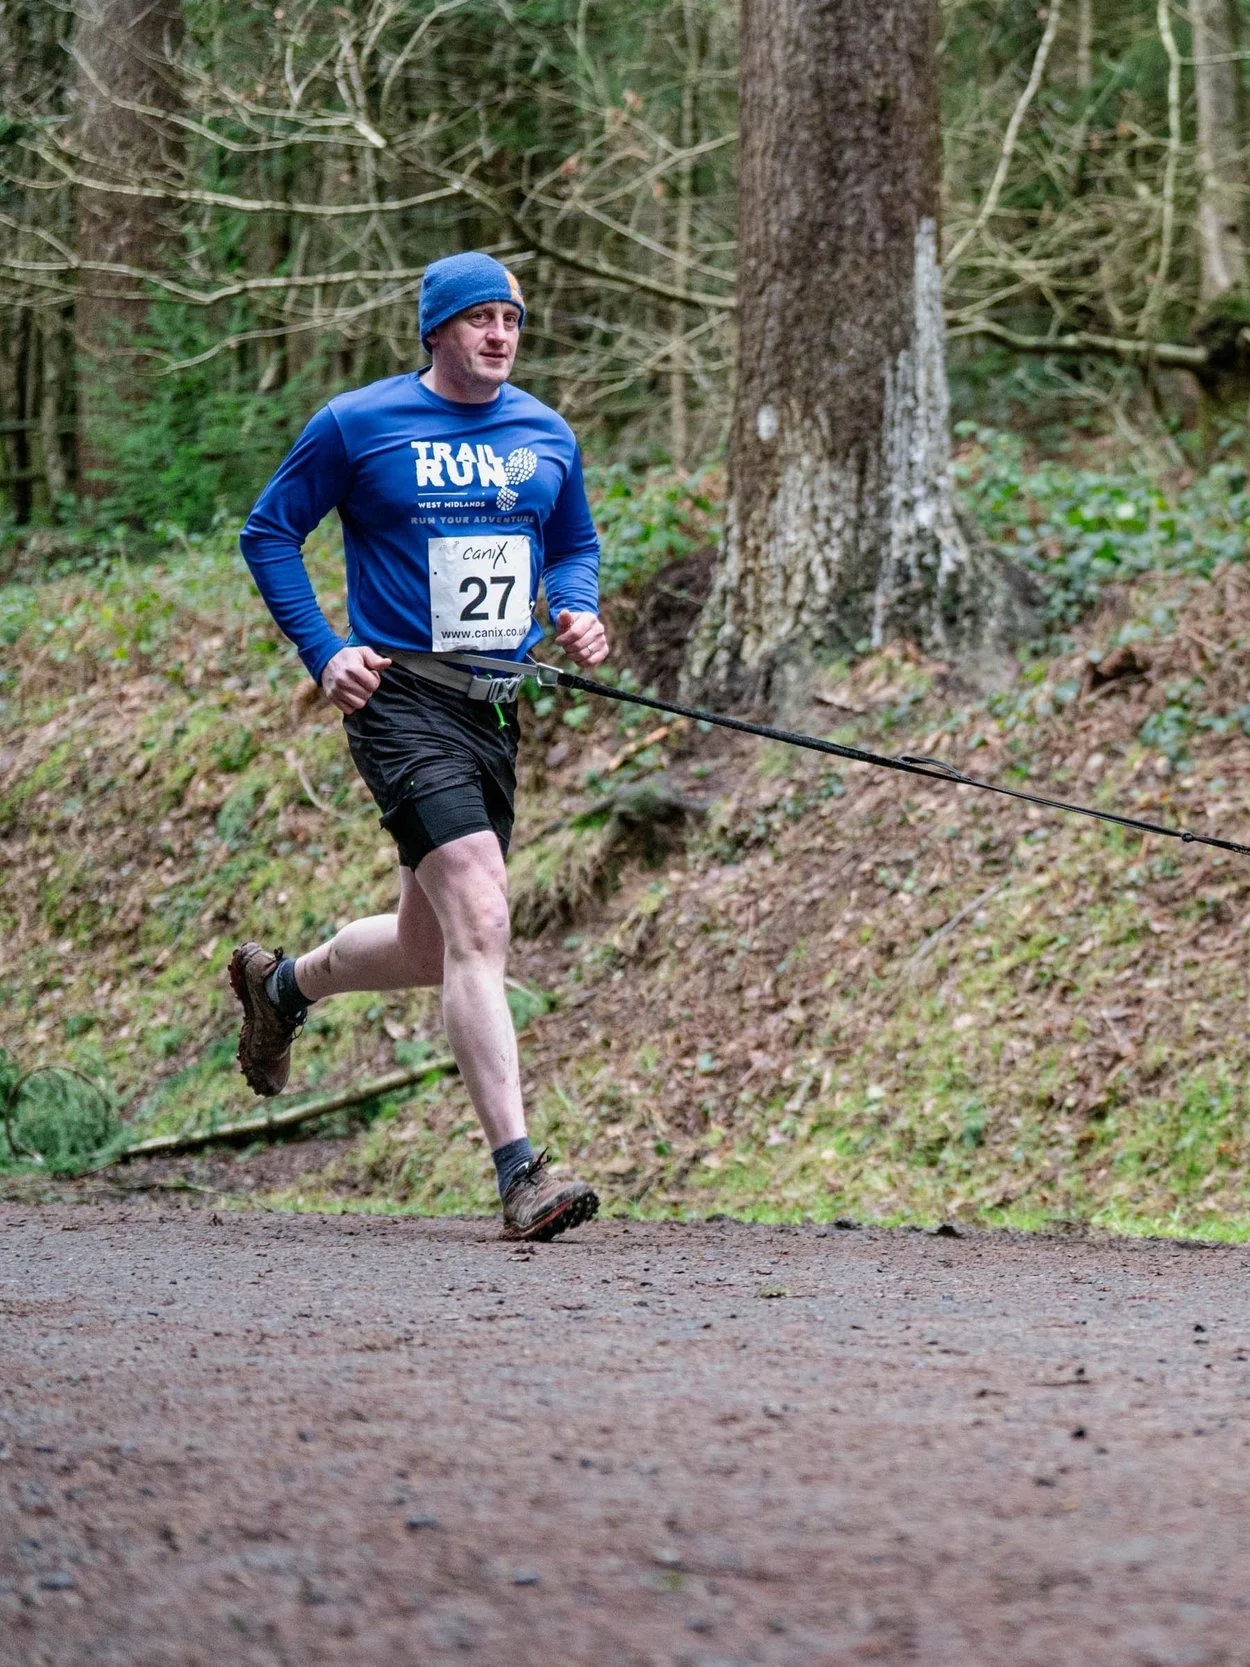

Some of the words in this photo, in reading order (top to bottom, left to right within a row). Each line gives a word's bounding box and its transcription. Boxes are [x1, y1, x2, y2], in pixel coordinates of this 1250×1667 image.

[411, 441, 504, 464] TRAIL
[415, 458, 507, 487] RUN
[418, 501, 441, 509] WEST
[410, 516, 436, 525] RUN
[440, 516, 469, 524] YOUR
[473, 515, 535, 524] ADVENTURE
[459, 575, 516, 621] 27
[441, 626, 527, 639] www.canix.co.uk
